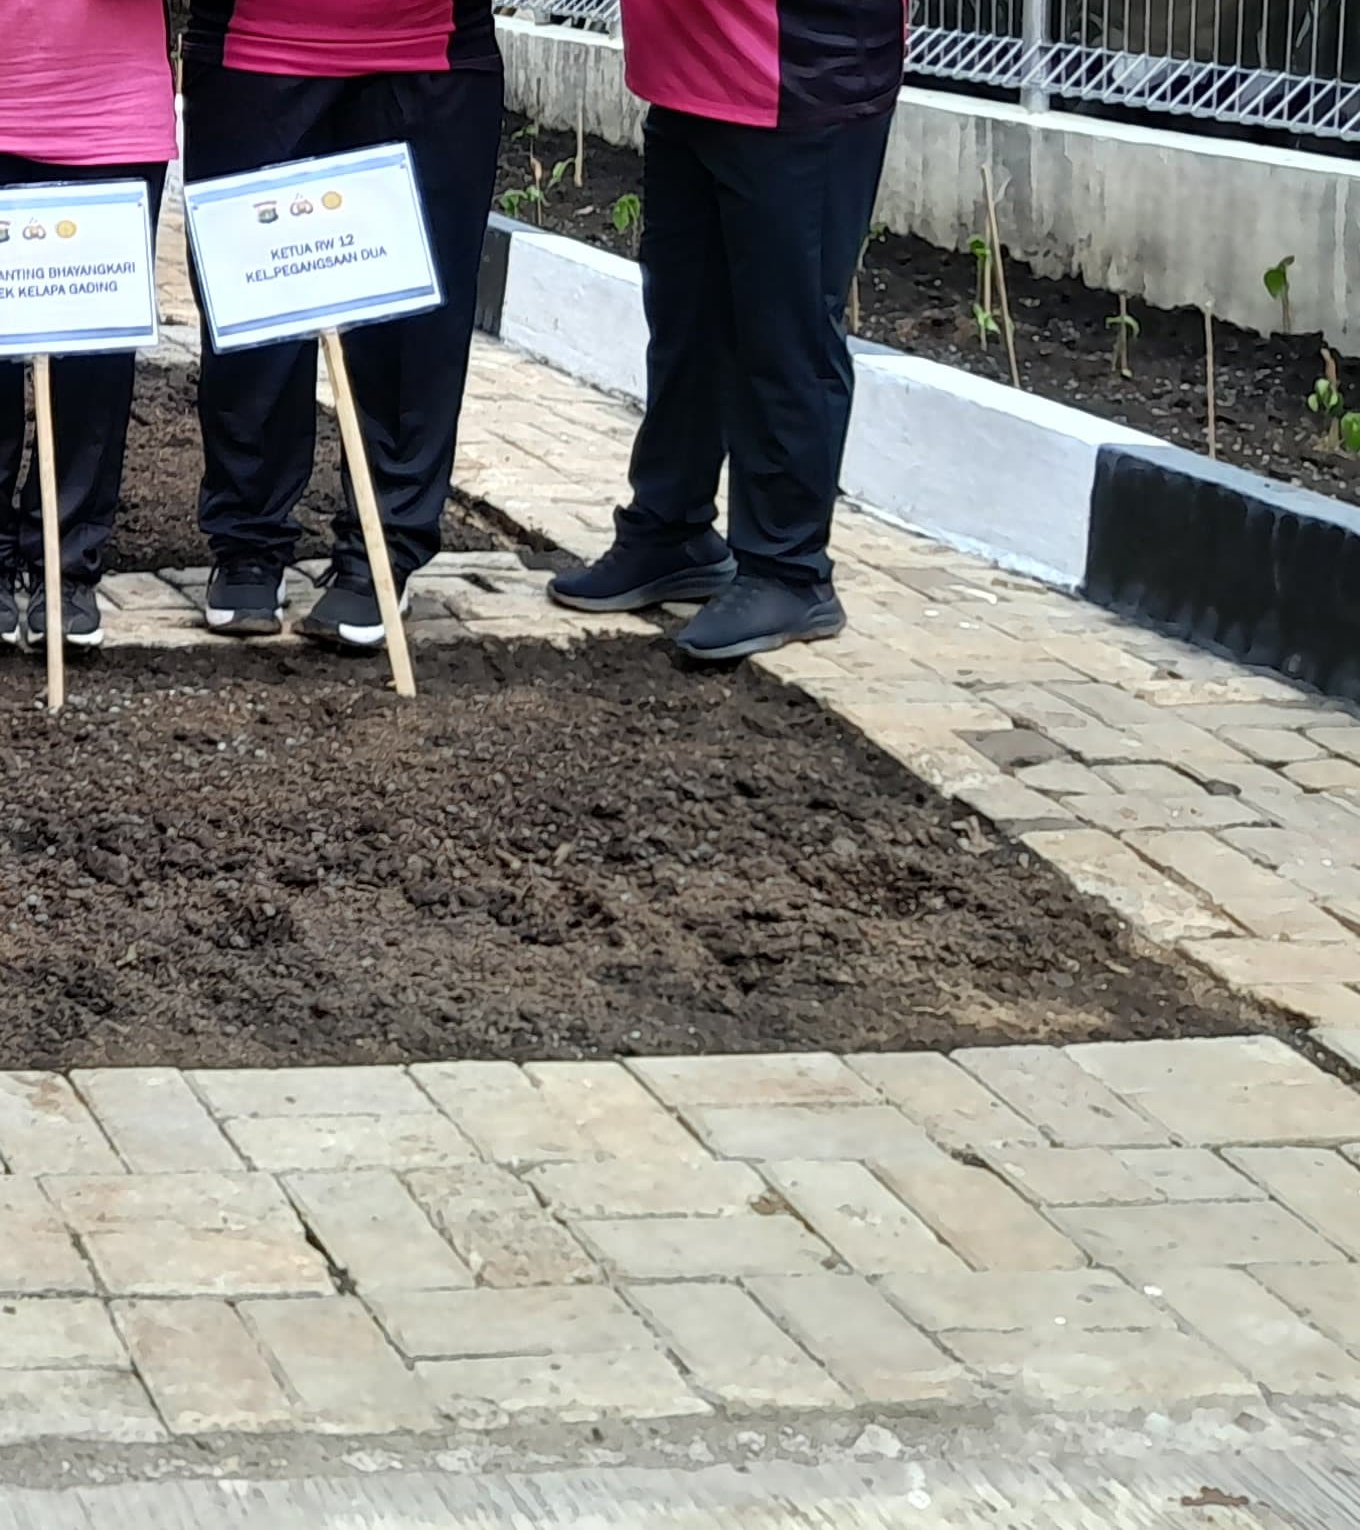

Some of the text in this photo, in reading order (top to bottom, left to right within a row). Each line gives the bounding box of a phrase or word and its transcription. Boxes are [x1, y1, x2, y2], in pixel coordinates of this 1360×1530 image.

[270, 233, 354, 261] KETUA RW 12
[360, 245, 387, 261] DUA
[48, 261, 136, 279] BHAYANGKARI
[18, 283, 66, 298] KELAPA
[69, 280, 118, 295] GADING
